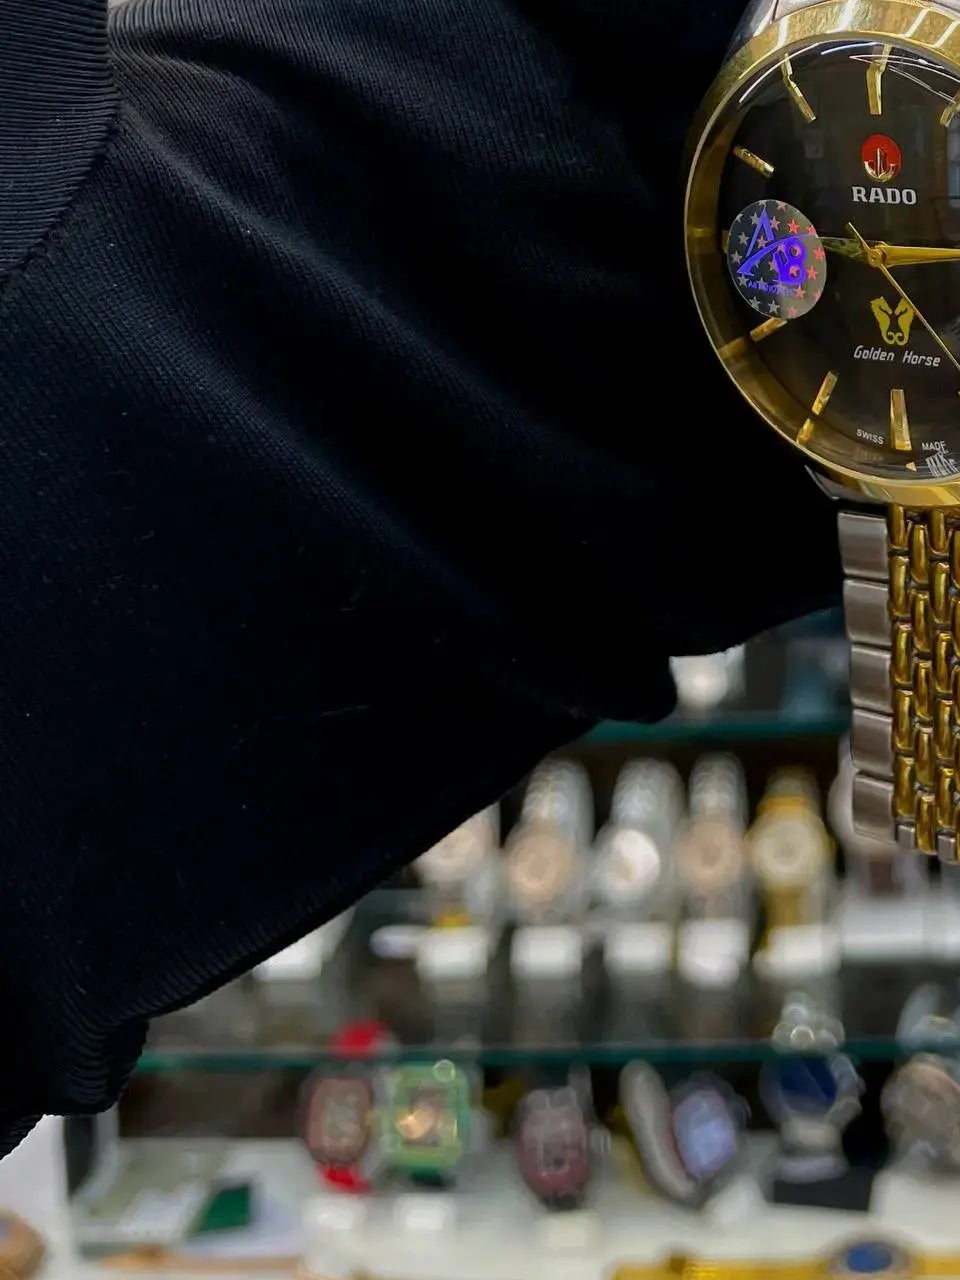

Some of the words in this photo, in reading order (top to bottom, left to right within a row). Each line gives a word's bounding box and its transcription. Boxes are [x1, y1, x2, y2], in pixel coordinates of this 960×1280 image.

[851, 186, 917, 205] RADO
[853, 345, 895, 361] Golden
[902, 350, 941, 367] Horse
[856, 428, 884, 445] SWISS
[921, 440, 947, 451] MADE
